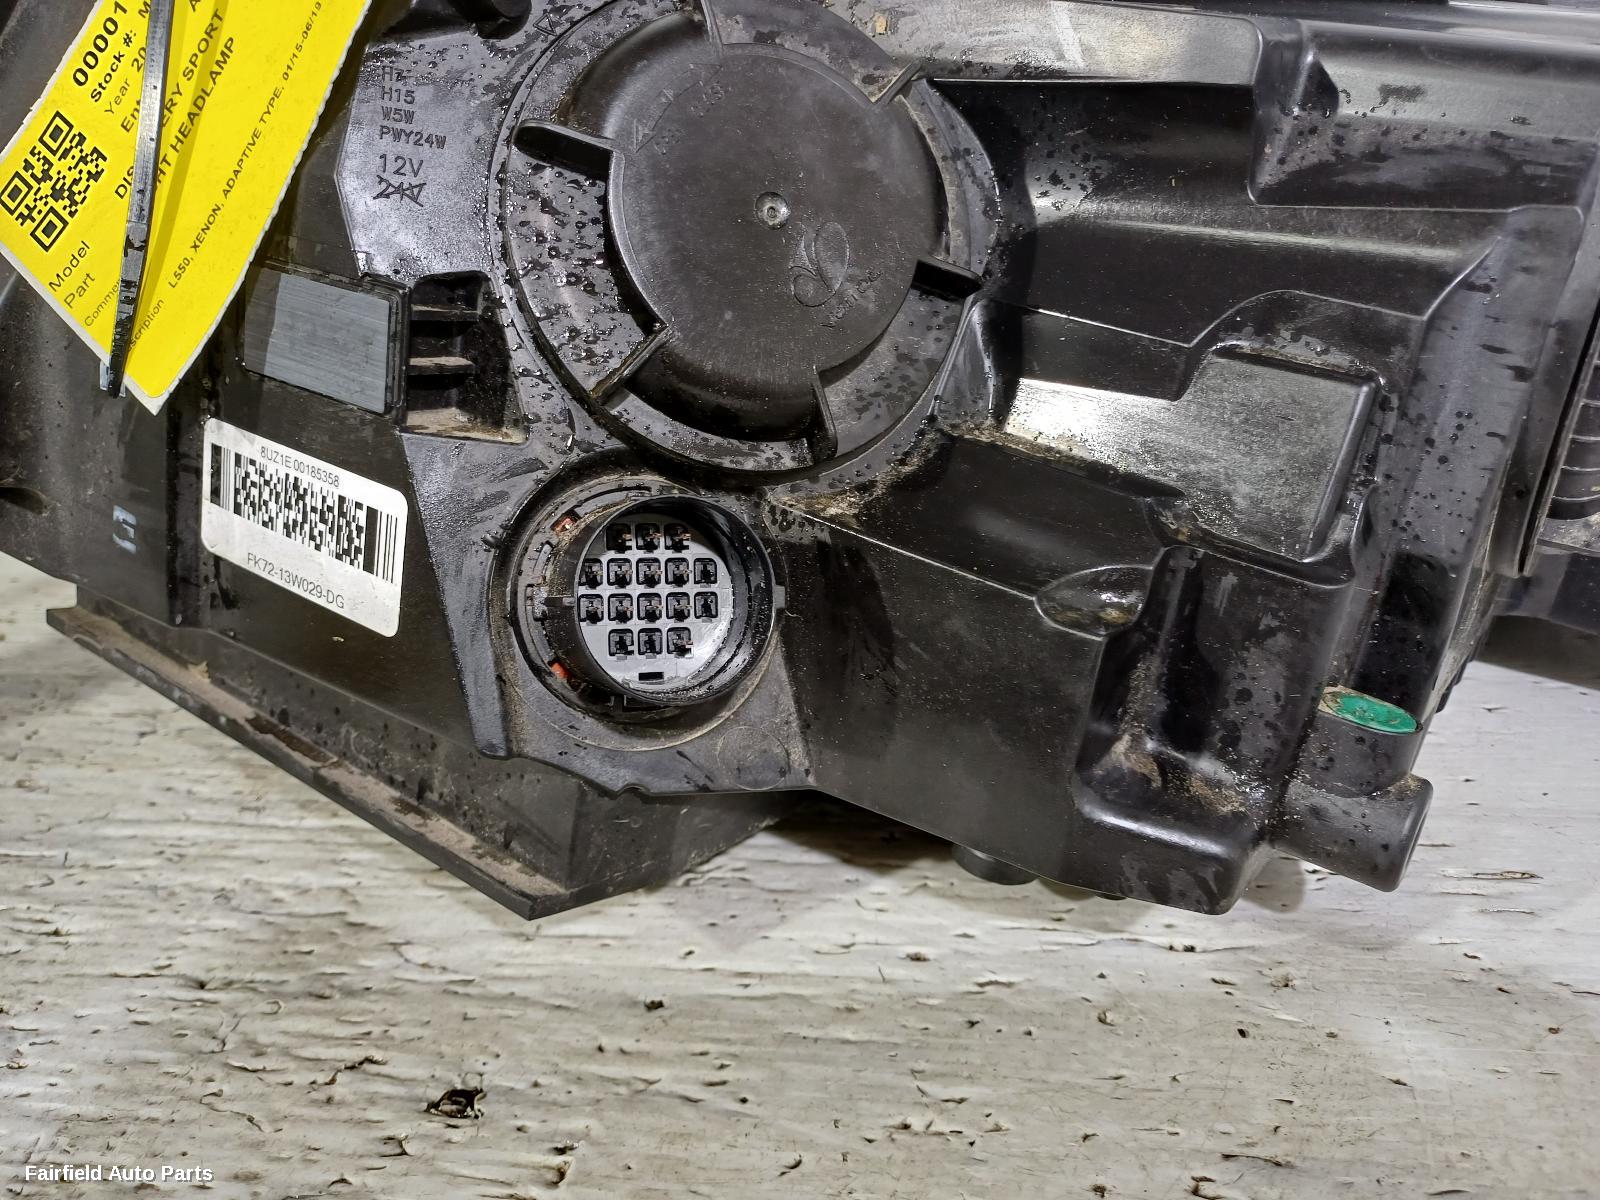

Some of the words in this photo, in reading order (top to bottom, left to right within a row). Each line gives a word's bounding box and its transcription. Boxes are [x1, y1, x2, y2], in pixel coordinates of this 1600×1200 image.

[90, 51, 125, 103] Stock
[104, 78, 130, 115] Year
[380, 85, 416, 105] H15
[222, 127, 262, 199] ADAPTIVE
[282, 1, 322, 81] 01/15-06/19
[381, 105, 415, 124] W5W
[48, 240, 90, 292] Model
[182, 8, 224, 82] SPORT
[379, 125, 447, 149] PWY24W
[63, 272, 95, 309] Part
[169, 36, 236, 154] HEADLAMP
[379, 153, 424, 178] 12V
[84, 279, 120, 327] Comme
[260, 446, 292, 469] 8UZ1E
[293, 459, 340, 488] 00185358
[246, 552, 346, 609] FK72-13W029-DG
